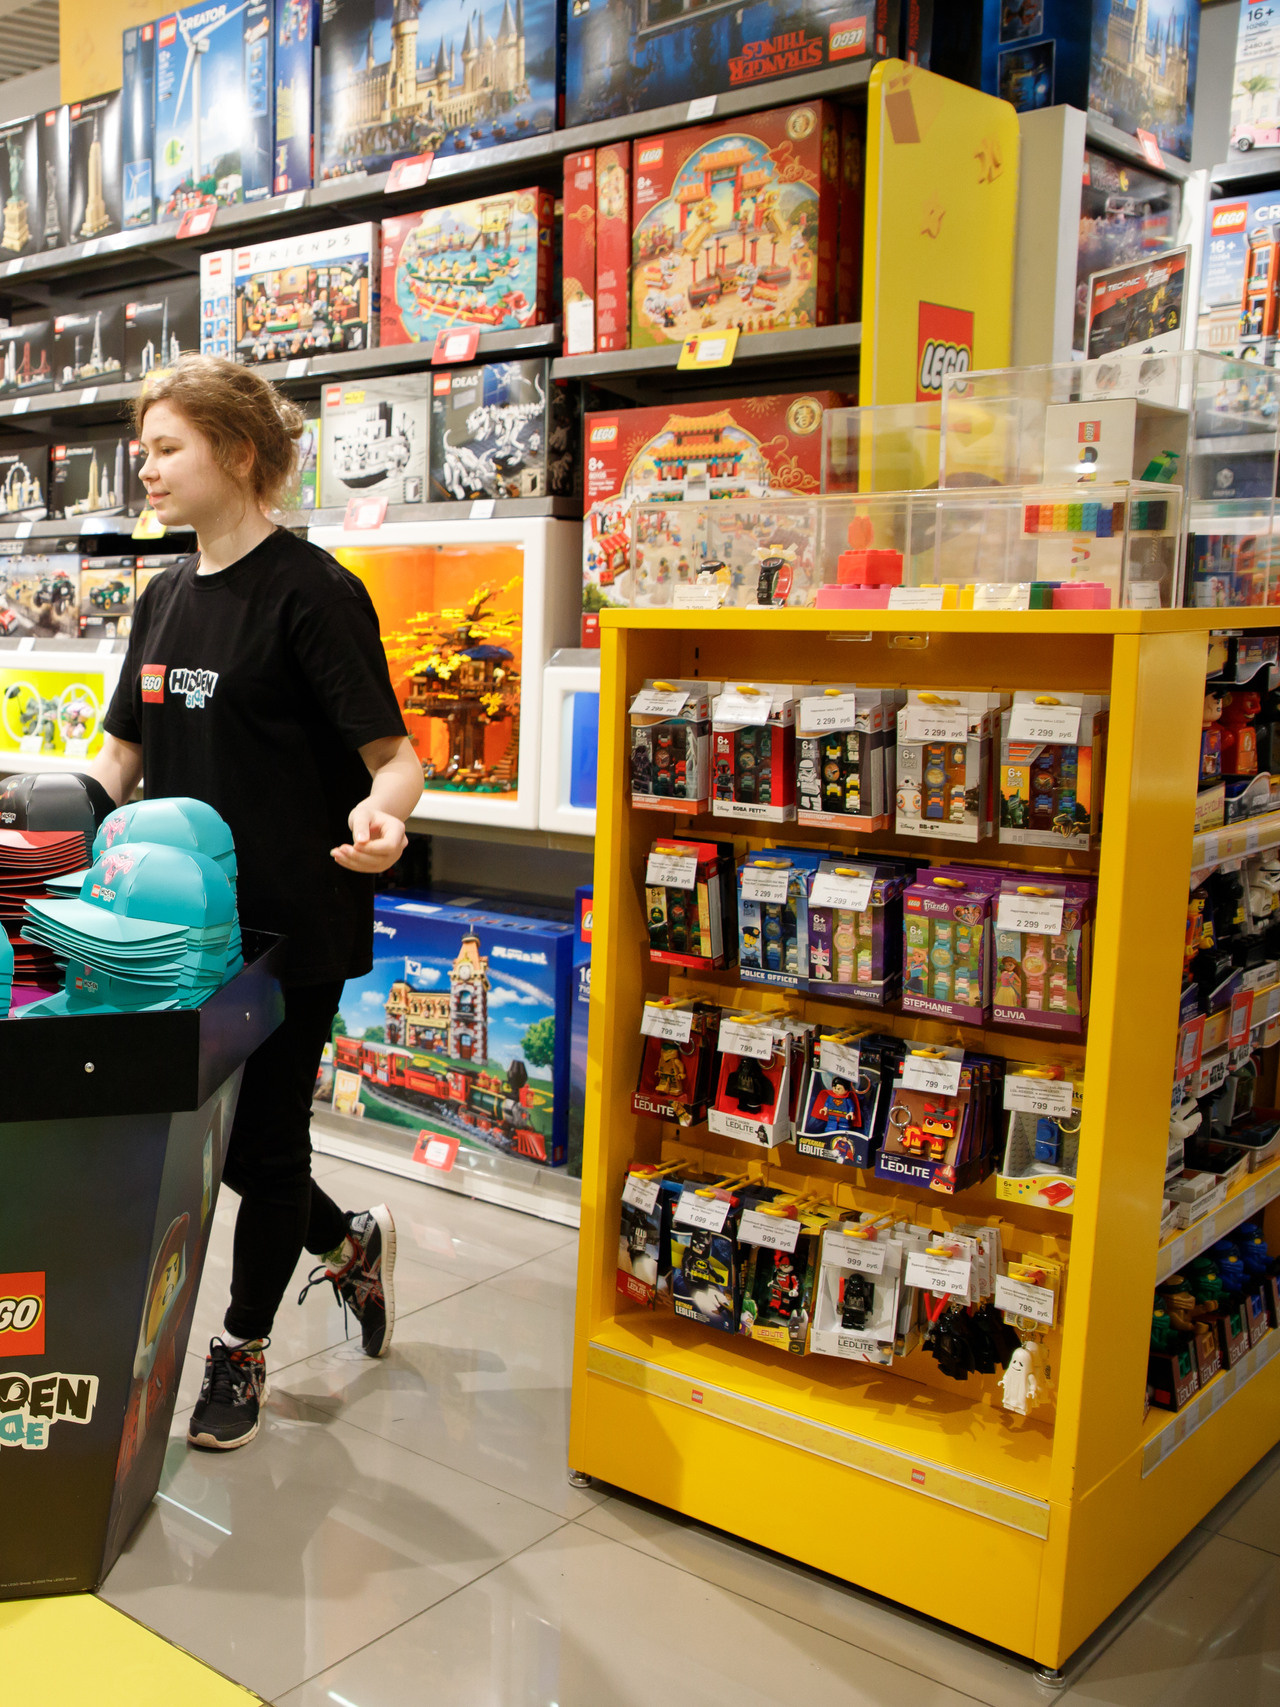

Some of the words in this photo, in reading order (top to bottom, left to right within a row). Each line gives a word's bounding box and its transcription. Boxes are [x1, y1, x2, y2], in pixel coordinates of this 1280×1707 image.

[180, 4, 227, 31] CREATOR
[1248, 8, 1274, 21] 16+
[742, 29, 808, 60] THINGS
[831, 28, 864, 51] LEGO
[729, 38, 823, 87] STRANGER
[638, 147, 664, 166] LEGO
[637, 176, 652, 190] 8+
[1213, 208, 1247, 228] LEGO
[255, 233, 351, 263] FRIENDS
[1210, 240, 1236, 252] 16+
[1107, 277, 1141, 292] TECHNIC
[920, 340, 970, 394] LEGO
[451, 376, 479, 389] IDEAS
[590, 426, 618, 444] LEGO
[1084, 423, 1096, 442] LEGO
[588, 457, 605, 471] 8+
[170, 669, 218, 697] HIDDEN
[816, 718, 821, 726] 2
[823, 717, 836, 725] 299
[635, 728, 647, 738] 6+
[931, 729, 946, 737] 299
[1029, 728, 1035, 736] 2
[1037, 728, 1054, 737] 299
[1059, 730, 1073, 738] руб.
[716, 736, 729, 746] 6+
[802, 741, 814, 750] 6+
[902, 750, 916, 759] 6+
[1007, 767, 1022, 778] 6+
[732, 805, 747, 813] BOBA
[666, 875, 678, 883] 299
[651, 889, 661, 897] 6+
[754, 889, 759, 897] 2
[759, 890, 772, 898] 299
[743, 900, 755, 909] 6+
[833, 897, 847, 905] 299
[923, 899, 949, 913] Friends
[813, 914, 826, 924] 6+
[1016, 919, 1022, 928] 2
[1023, 920, 1039, 929] 299
[1044, 922, 1058, 931] руб.
[909, 925, 923, 936] 6+
[999, 934, 1014, 945] 6+
[740, 969, 766, 980] POLICE
[767, 974, 799, 985] OFFICER
[853, 989, 880, 1000] UNIKITTY
[903, 997, 954, 1015] STEPHANIE
[994, 1008, 1027, 1022] OLIVIA
[660, 1027, 673, 1037] 799
[740, 1044, 753, 1053] 799
[1209, 1061, 1225, 1075] STAR
[924, 1080, 939, 1089] 799
[1209, 1070, 1225, 1086] WARS
[634, 1099, 675, 1118] LEDLITE
[1032, 1101, 1048, 1111] 799
[725, 1119, 754, 1134] LEDLITE
[798, 1143, 824, 1158] LEDLITE
[880, 1159, 931, 1179] LEDLITE
[1003, 1180, 1012, 1188] 6+
[695, 1215, 707, 1225] 099
[762, 1234, 776, 1244] 999
[847, 1257, 862, 1267] 999
[627, 1280, 647, 1297] LEDLITE
[931, 1278, 947, 1288] 799
[675, 1305, 698, 1321] LEDLITE
[1018, 1303, 1033, 1313] 799
[1036, 1309, 1050, 1318] руб.
[757, 1328, 771, 1338] LED
[771, 1329, 785, 1339] LITE
[838, 1340, 874, 1352] LEDLITE
[1230, 1339, 1250, 1364] LEDLITE
[1200, 1360, 1221, 1385] LEDLITE
[1178, 1380, 1199, 1406] LEDLITE
